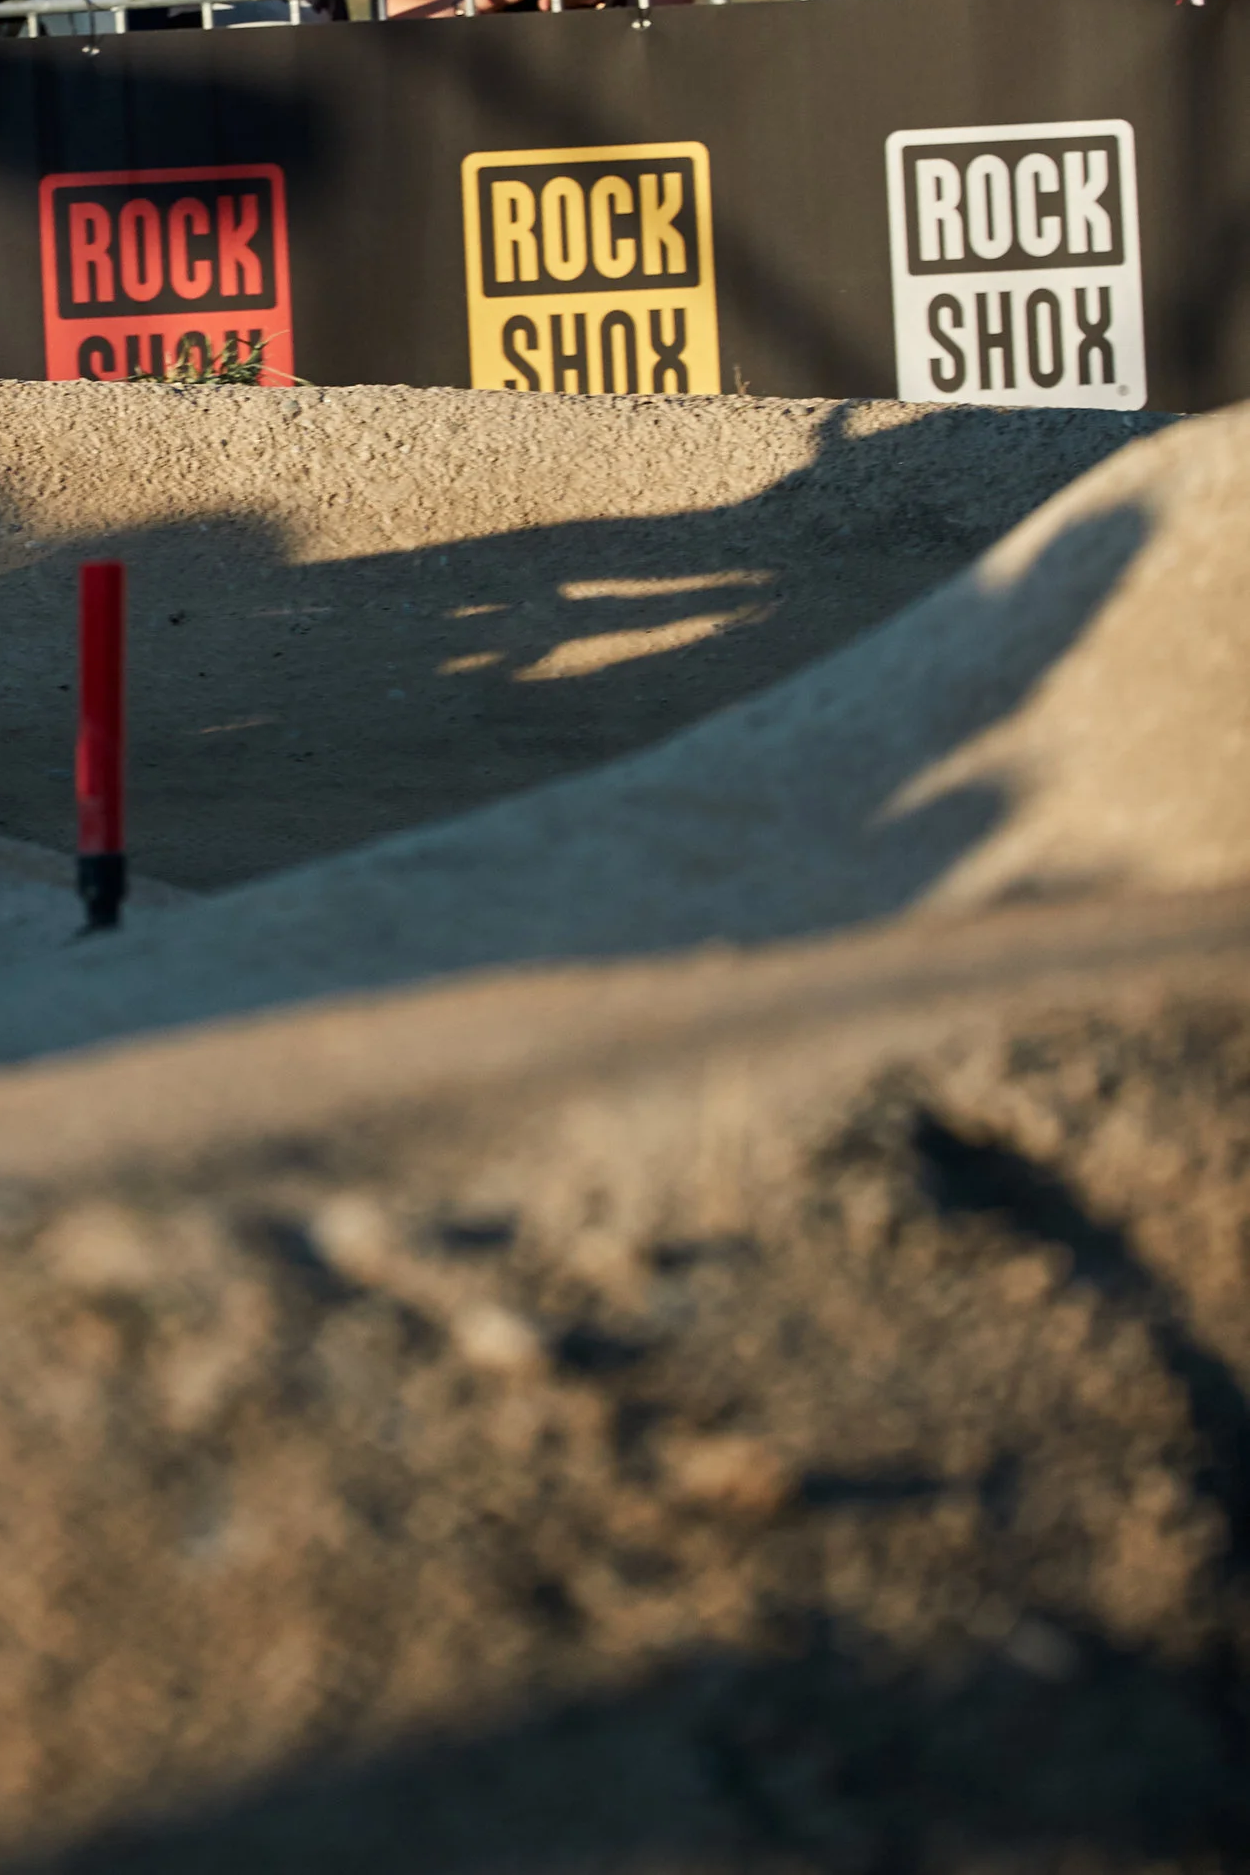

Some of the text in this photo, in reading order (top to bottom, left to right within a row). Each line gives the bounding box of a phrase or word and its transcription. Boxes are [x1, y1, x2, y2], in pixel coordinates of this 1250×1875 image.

[68, 193, 263, 304] ROCK
[490, 171, 687, 283] ROCK
[914, 149, 1113, 262] ROCK
[502, 307, 689, 394] SHOX
[927, 285, 1116, 394] SHOX
